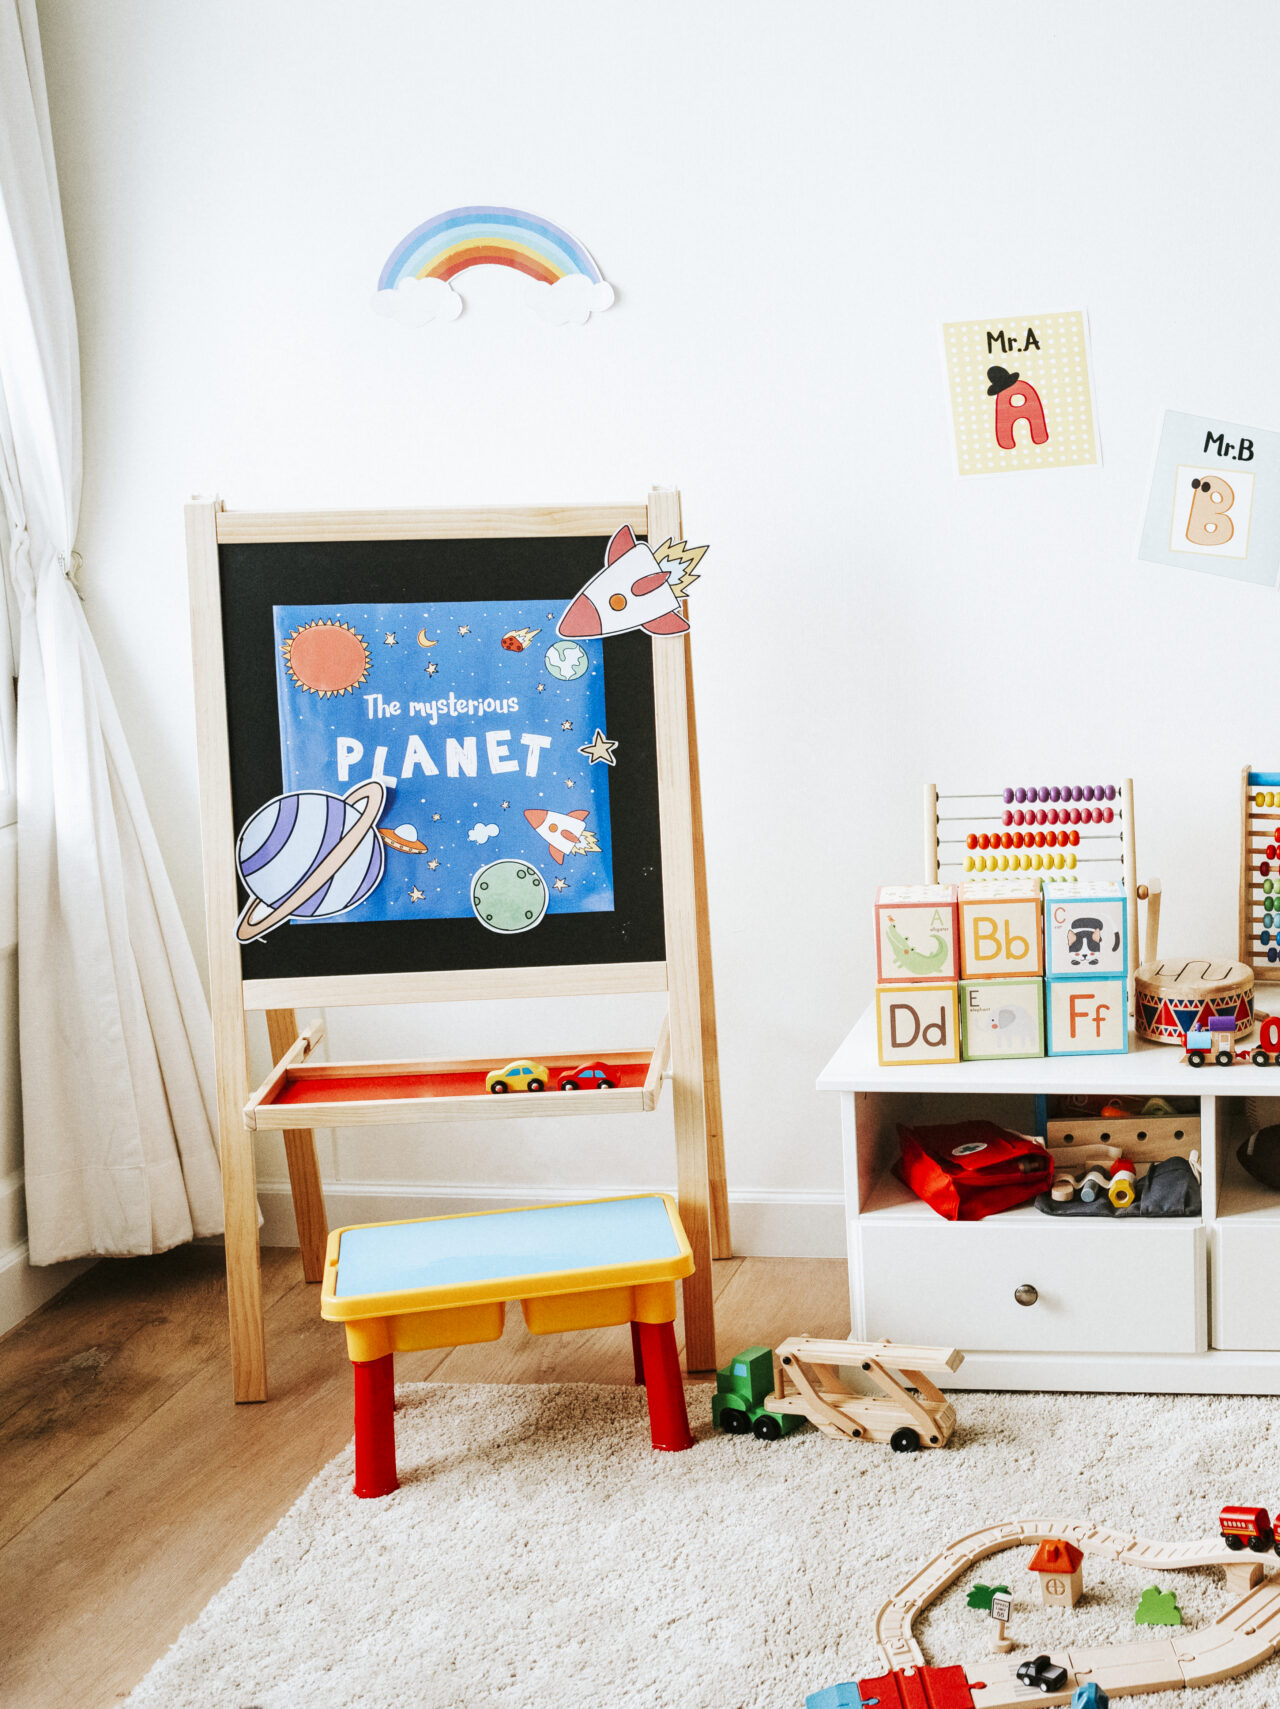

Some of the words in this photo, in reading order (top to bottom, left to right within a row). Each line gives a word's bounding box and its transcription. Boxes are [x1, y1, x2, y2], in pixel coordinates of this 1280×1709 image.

[986, 327, 1041, 354] Mr.A
[1203, 431, 1254, 462] Mr.B
[1185, 475, 1236, 547] B
[363, 693, 402, 720] The
[409, 691, 519, 726] mysterious
[336, 729, 552, 789] PLANET
[930, 908, 944, 926] A
[1054, 906, 1066, 924] C
[973, 917, 1030, 962] Bb
[969, 990, 980, 1007] E
[889, 1003, 946, 1049] Dd
[1069, 994, 1110, 1039] Ff
